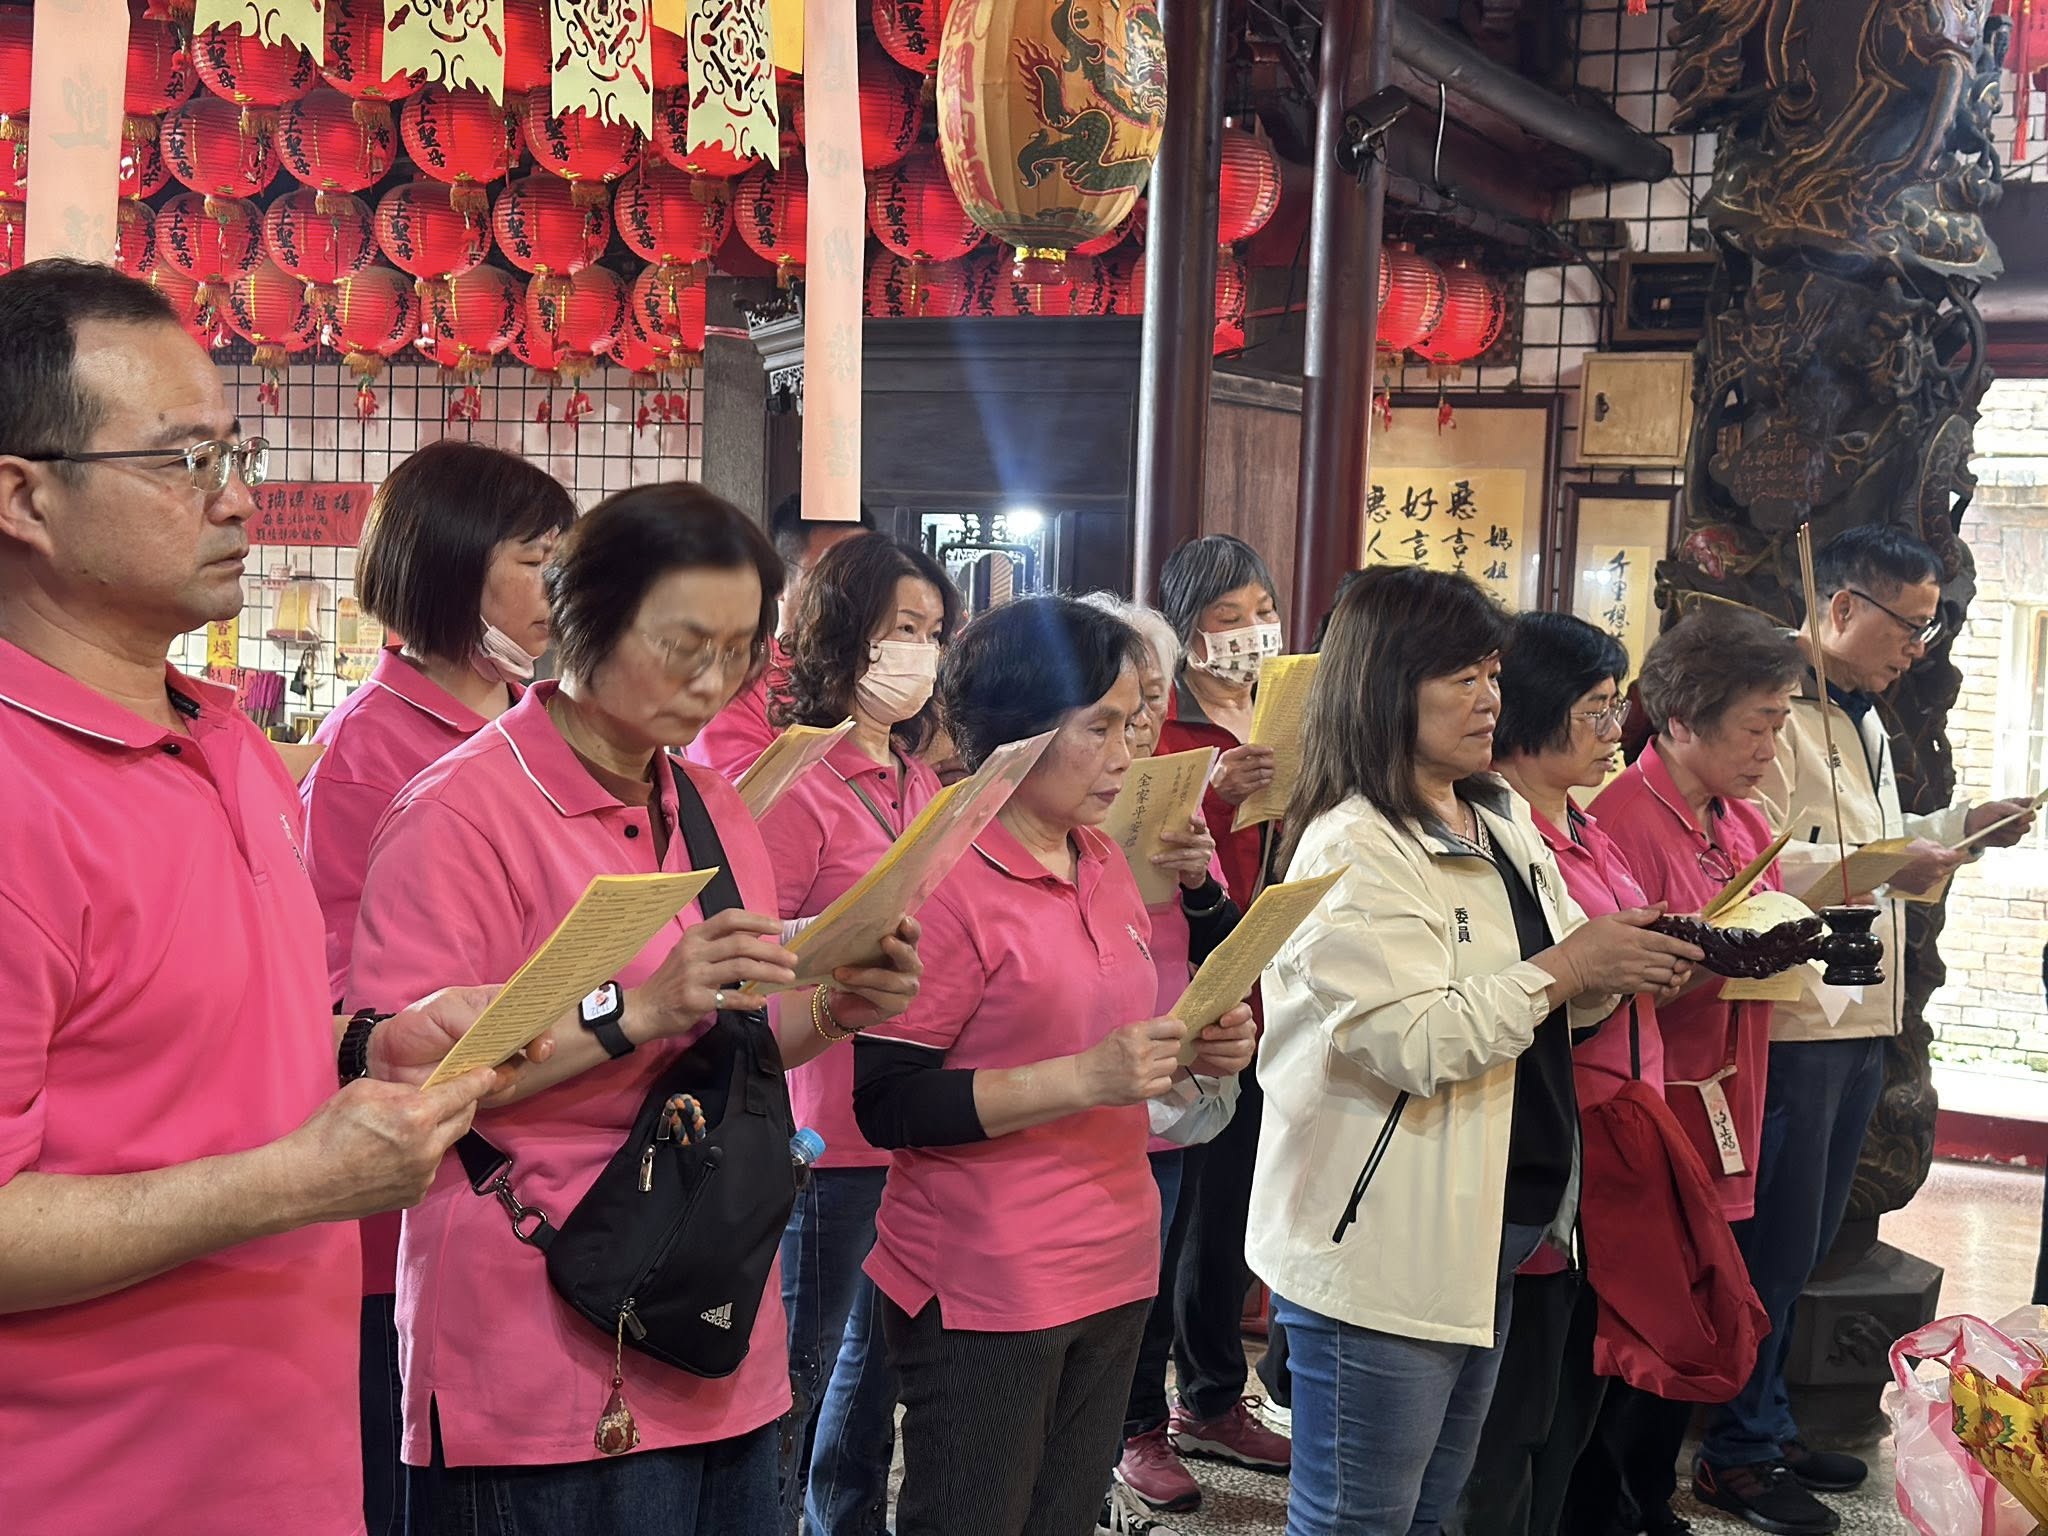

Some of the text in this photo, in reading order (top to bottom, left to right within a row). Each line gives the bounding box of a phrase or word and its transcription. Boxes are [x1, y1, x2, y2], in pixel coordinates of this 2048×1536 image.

[1483, 524, 1513, 602] 媽祖
[1454, 907, 1471, 943] 委員
[700, 1311, 732, 1329] adidas
